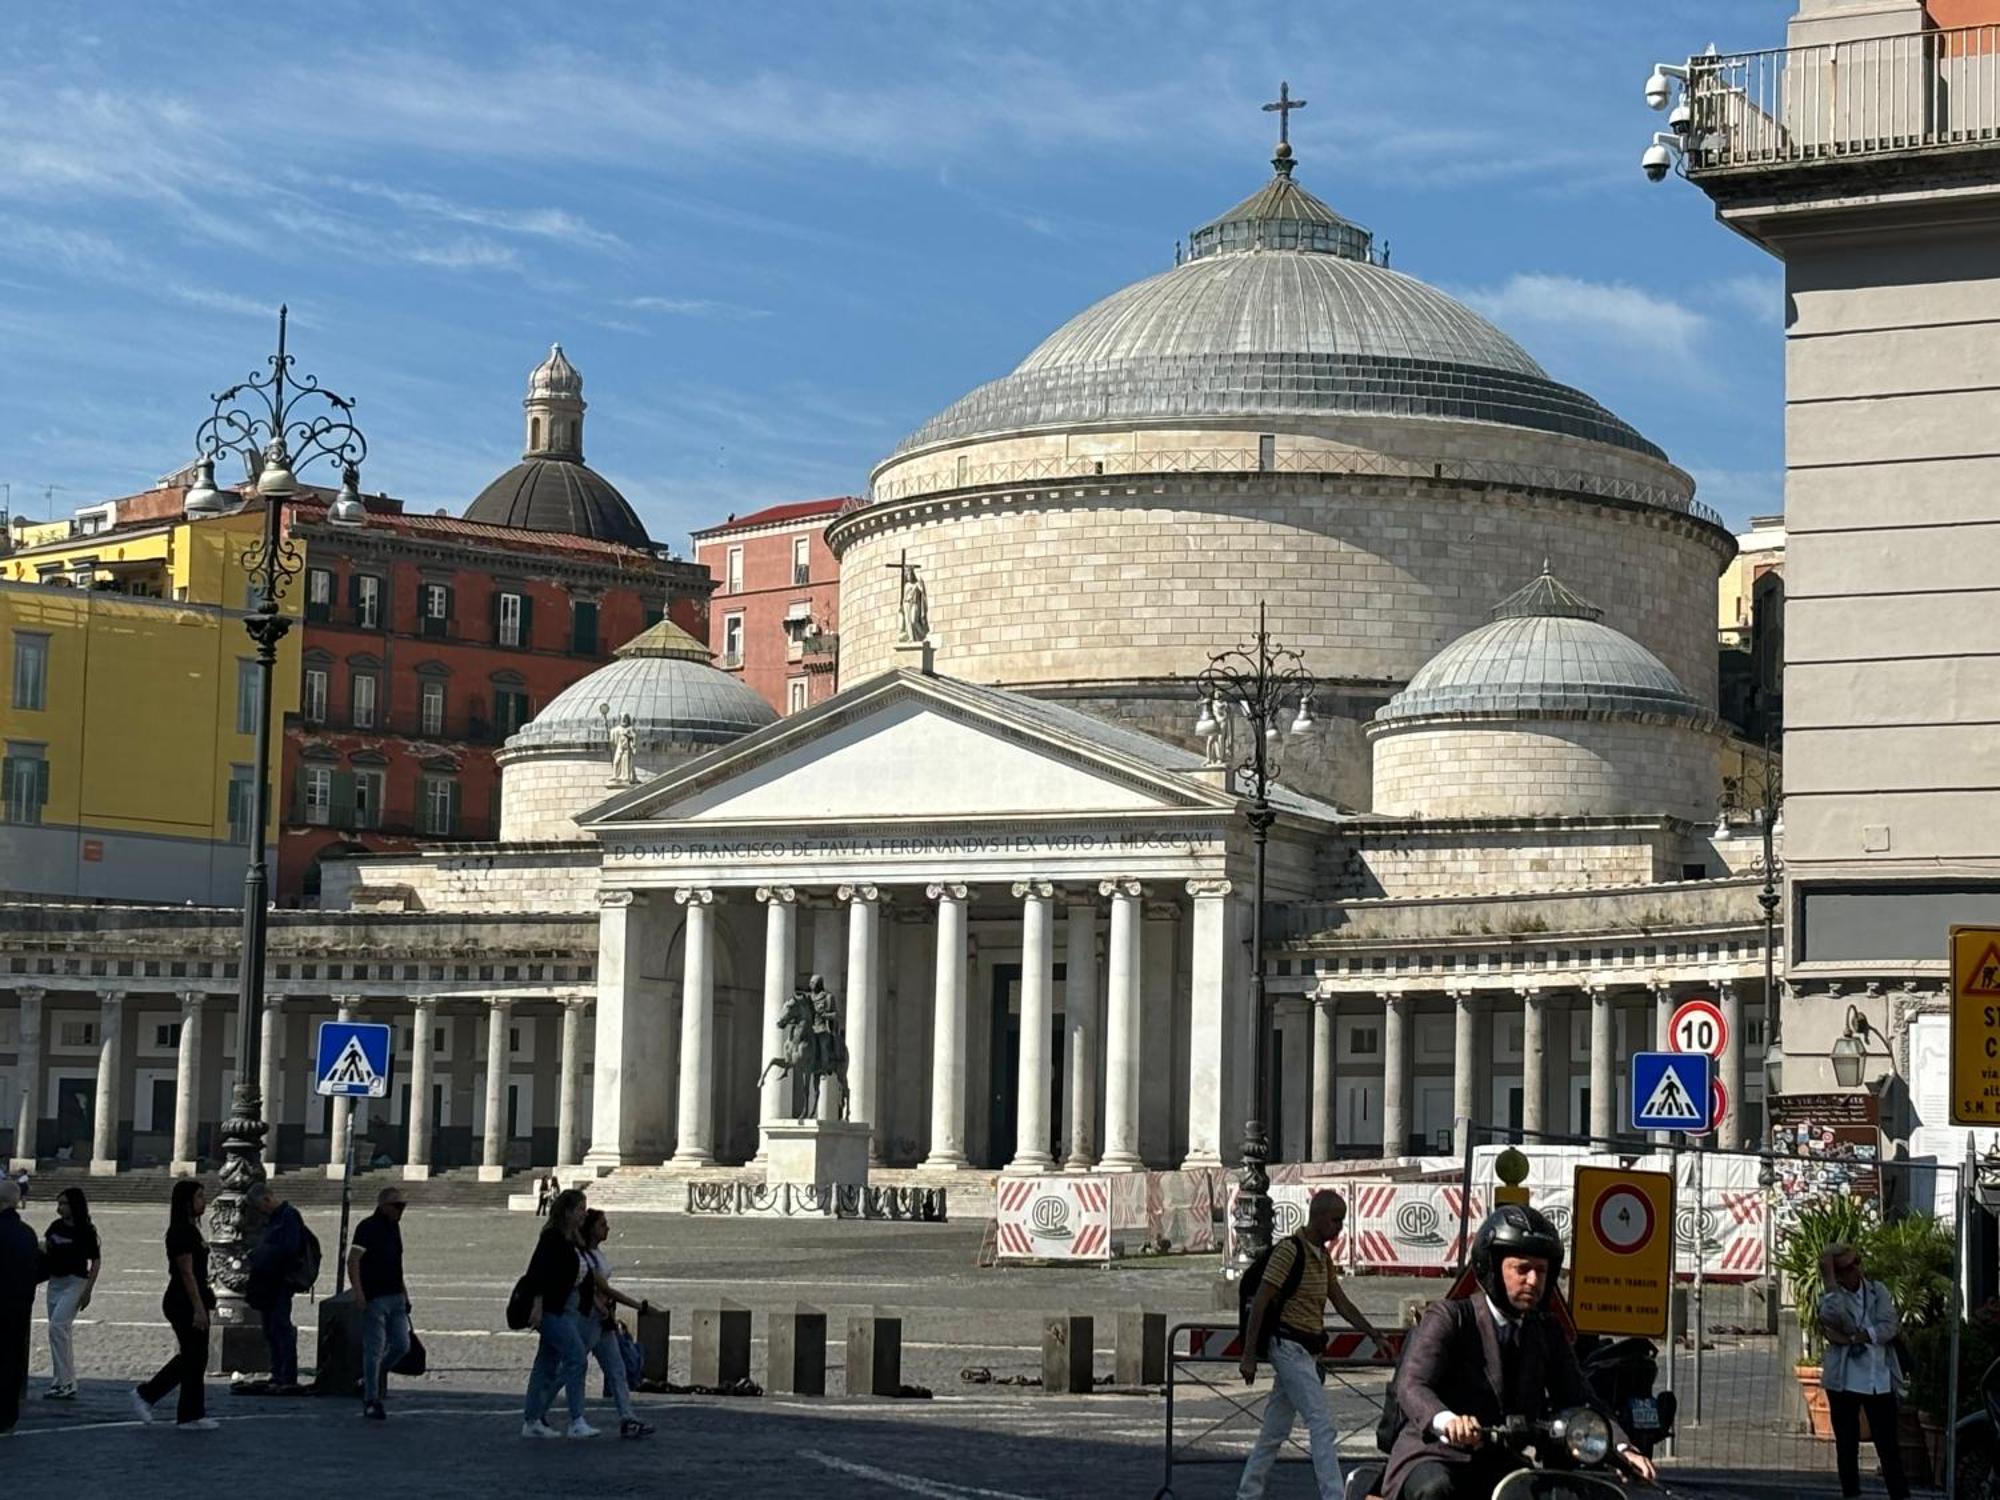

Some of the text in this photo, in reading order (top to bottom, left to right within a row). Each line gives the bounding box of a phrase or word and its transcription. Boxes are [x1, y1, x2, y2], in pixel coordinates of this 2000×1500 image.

[614, 845, 626, 861] D
[633, 844, 646, 860] O
[652, 844, 665, 860] M
[671, 843, 682, 859] D
[689, 841, 785, 859] FRANCISCO
[792, 840, 813, 857] DE
[820, 839, 872, 857] PAVLA
[881, 836, 999, 856] FERDINANDVS
[1015, 836, 1037, 853] EX
[1044, 834, 1095, 851] VOTO
[1119, 832, 1213, 849] MDCCCXVI
[1681, 1020, 1713, 1050] 10
